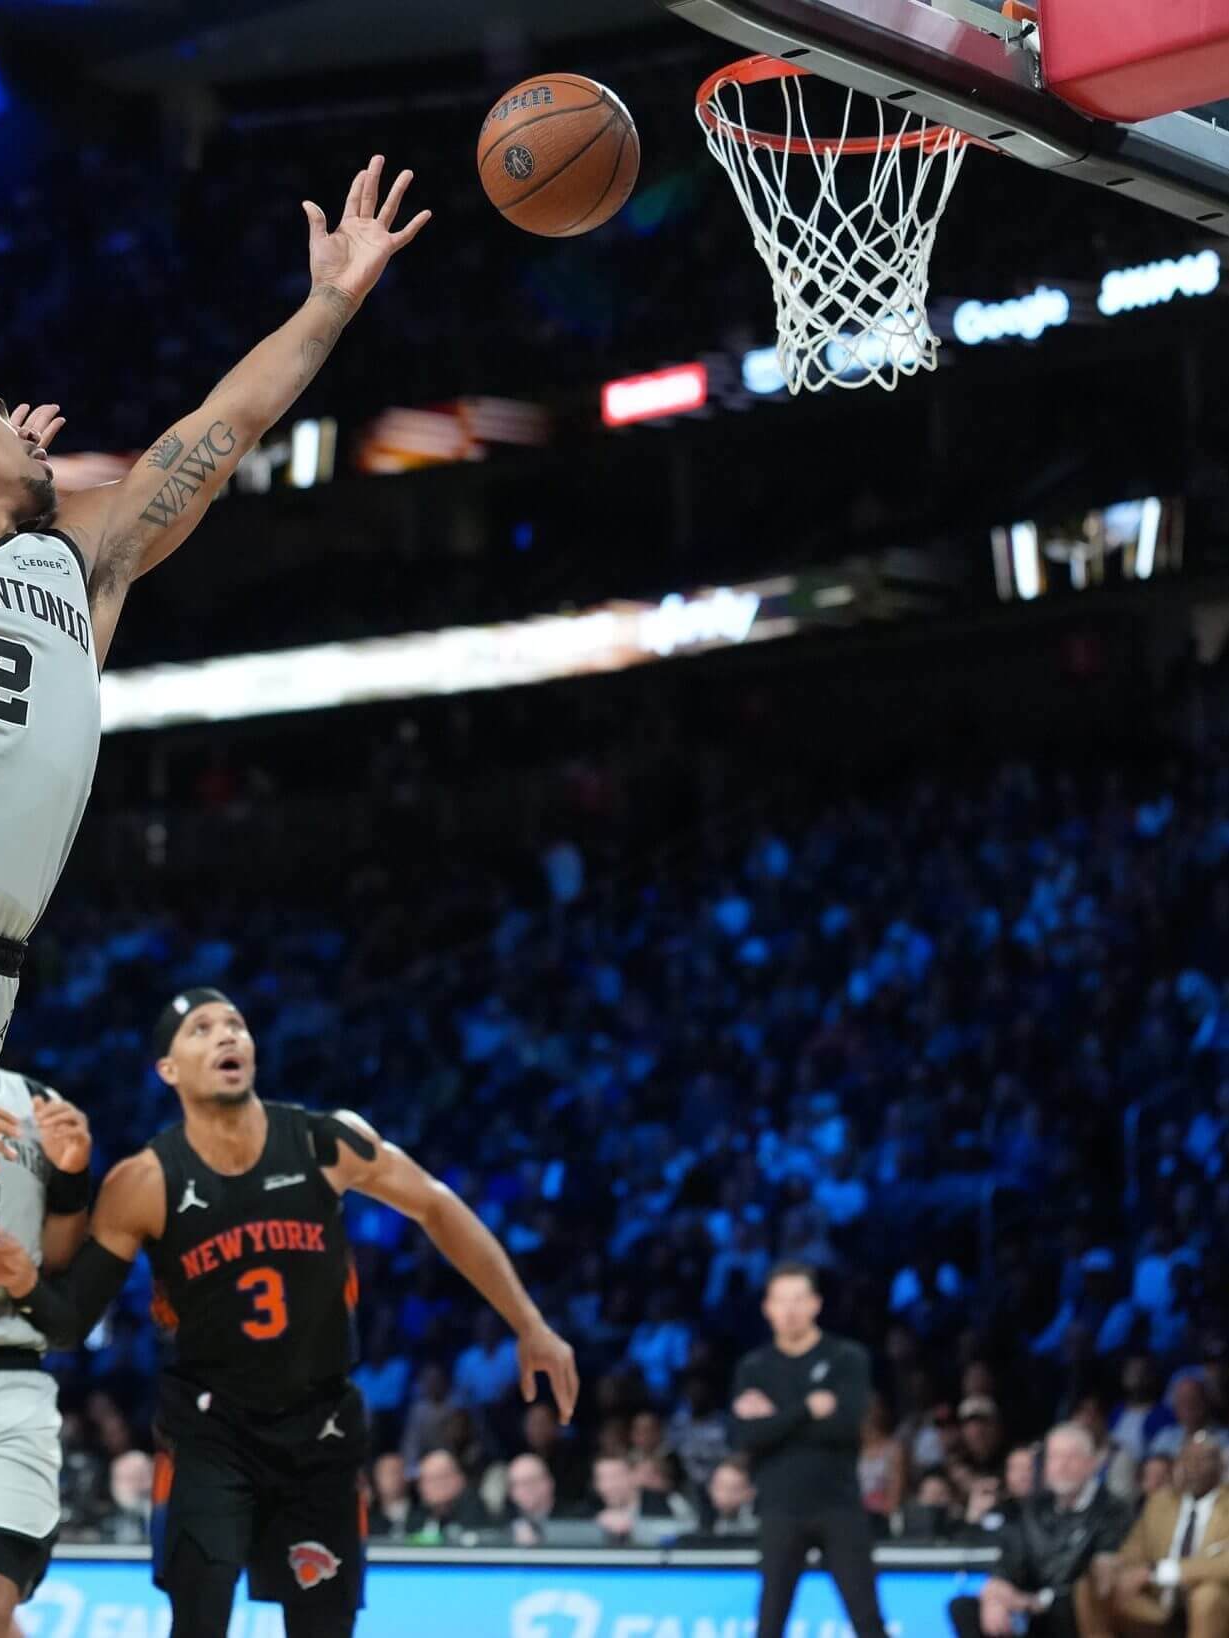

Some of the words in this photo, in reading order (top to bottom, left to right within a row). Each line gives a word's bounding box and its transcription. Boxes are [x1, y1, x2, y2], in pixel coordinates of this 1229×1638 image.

[138, 420, 236, 528] WAWG
[22, 558, 63, 570] LEDGER
[179, 1225, 243, 1281] NEW
[244, 1219, 326, 1252] YORK
[235, 1265, 289, 1341] 3
